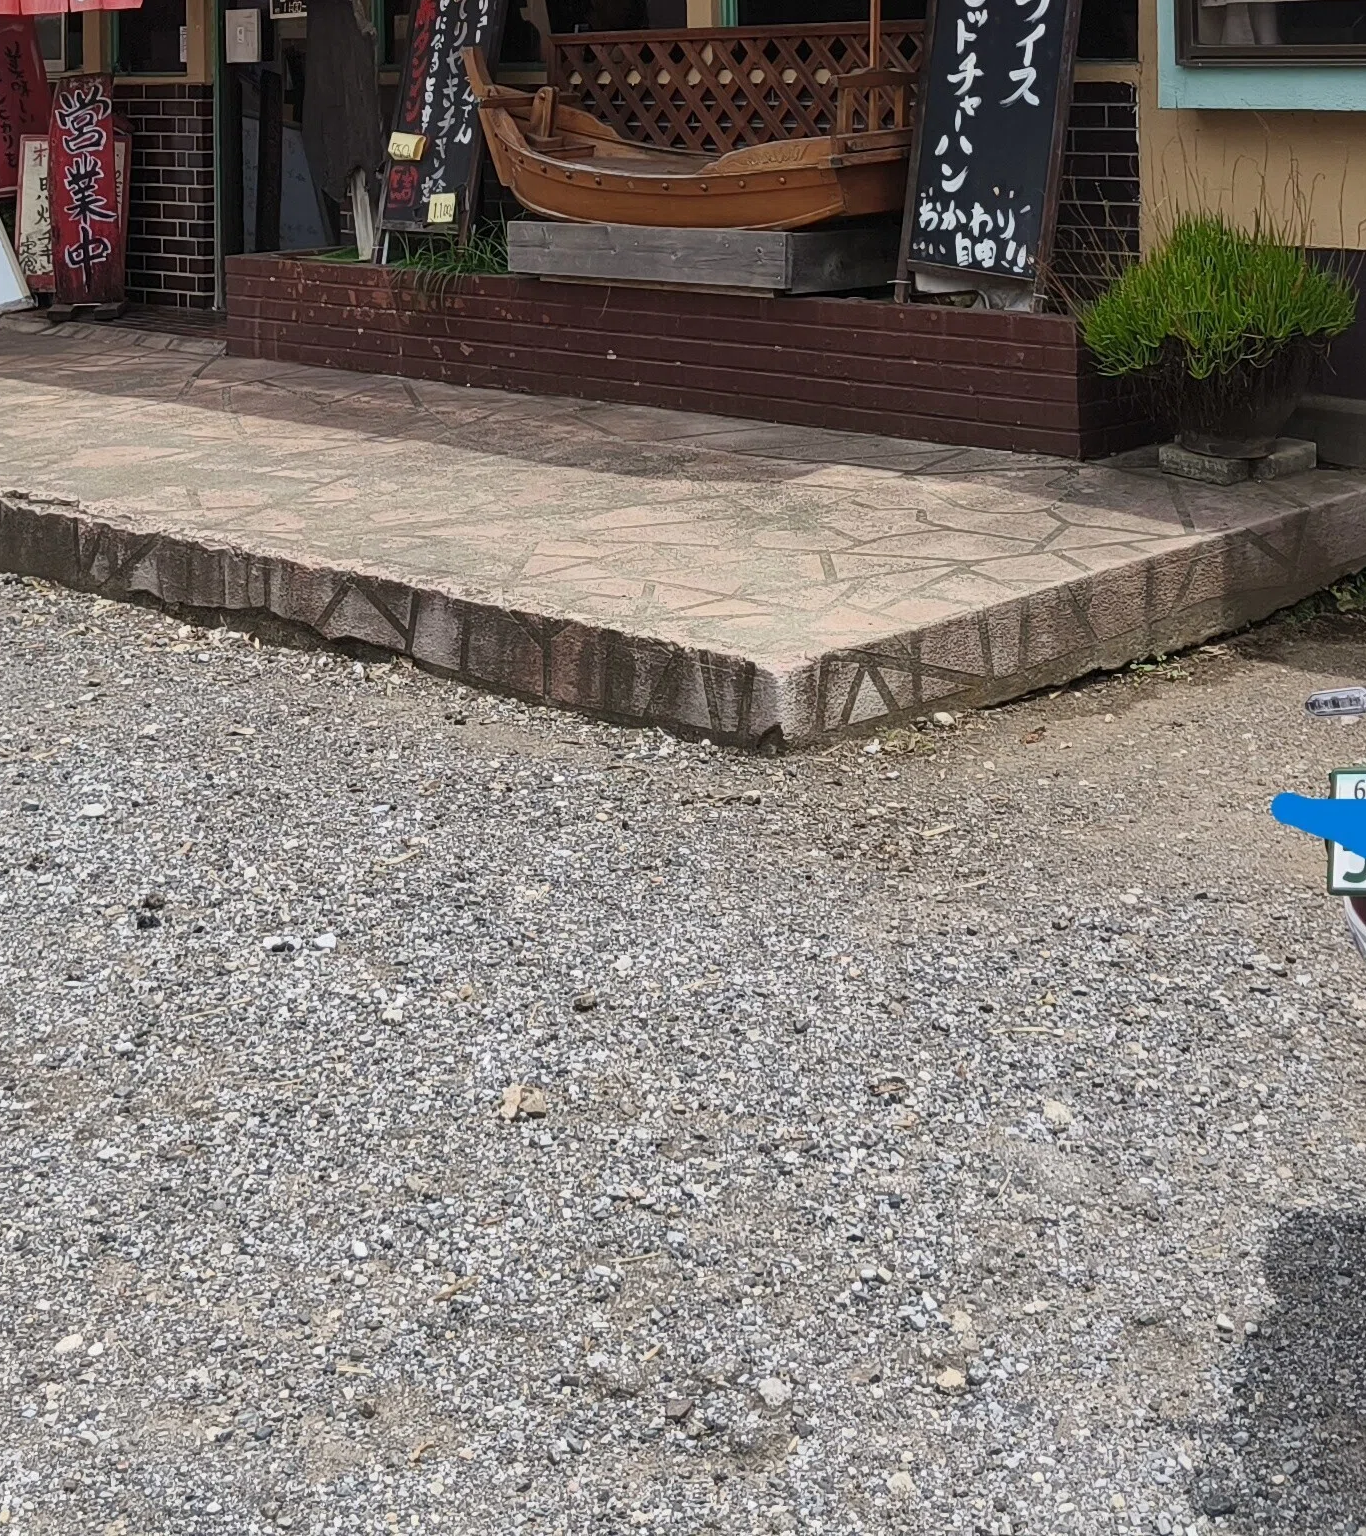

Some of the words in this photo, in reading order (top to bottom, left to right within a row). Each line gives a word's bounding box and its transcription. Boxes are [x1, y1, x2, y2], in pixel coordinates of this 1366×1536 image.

[55, 83, 117, 294] 営業中
[918, 199, 1016, 240] おかわり
